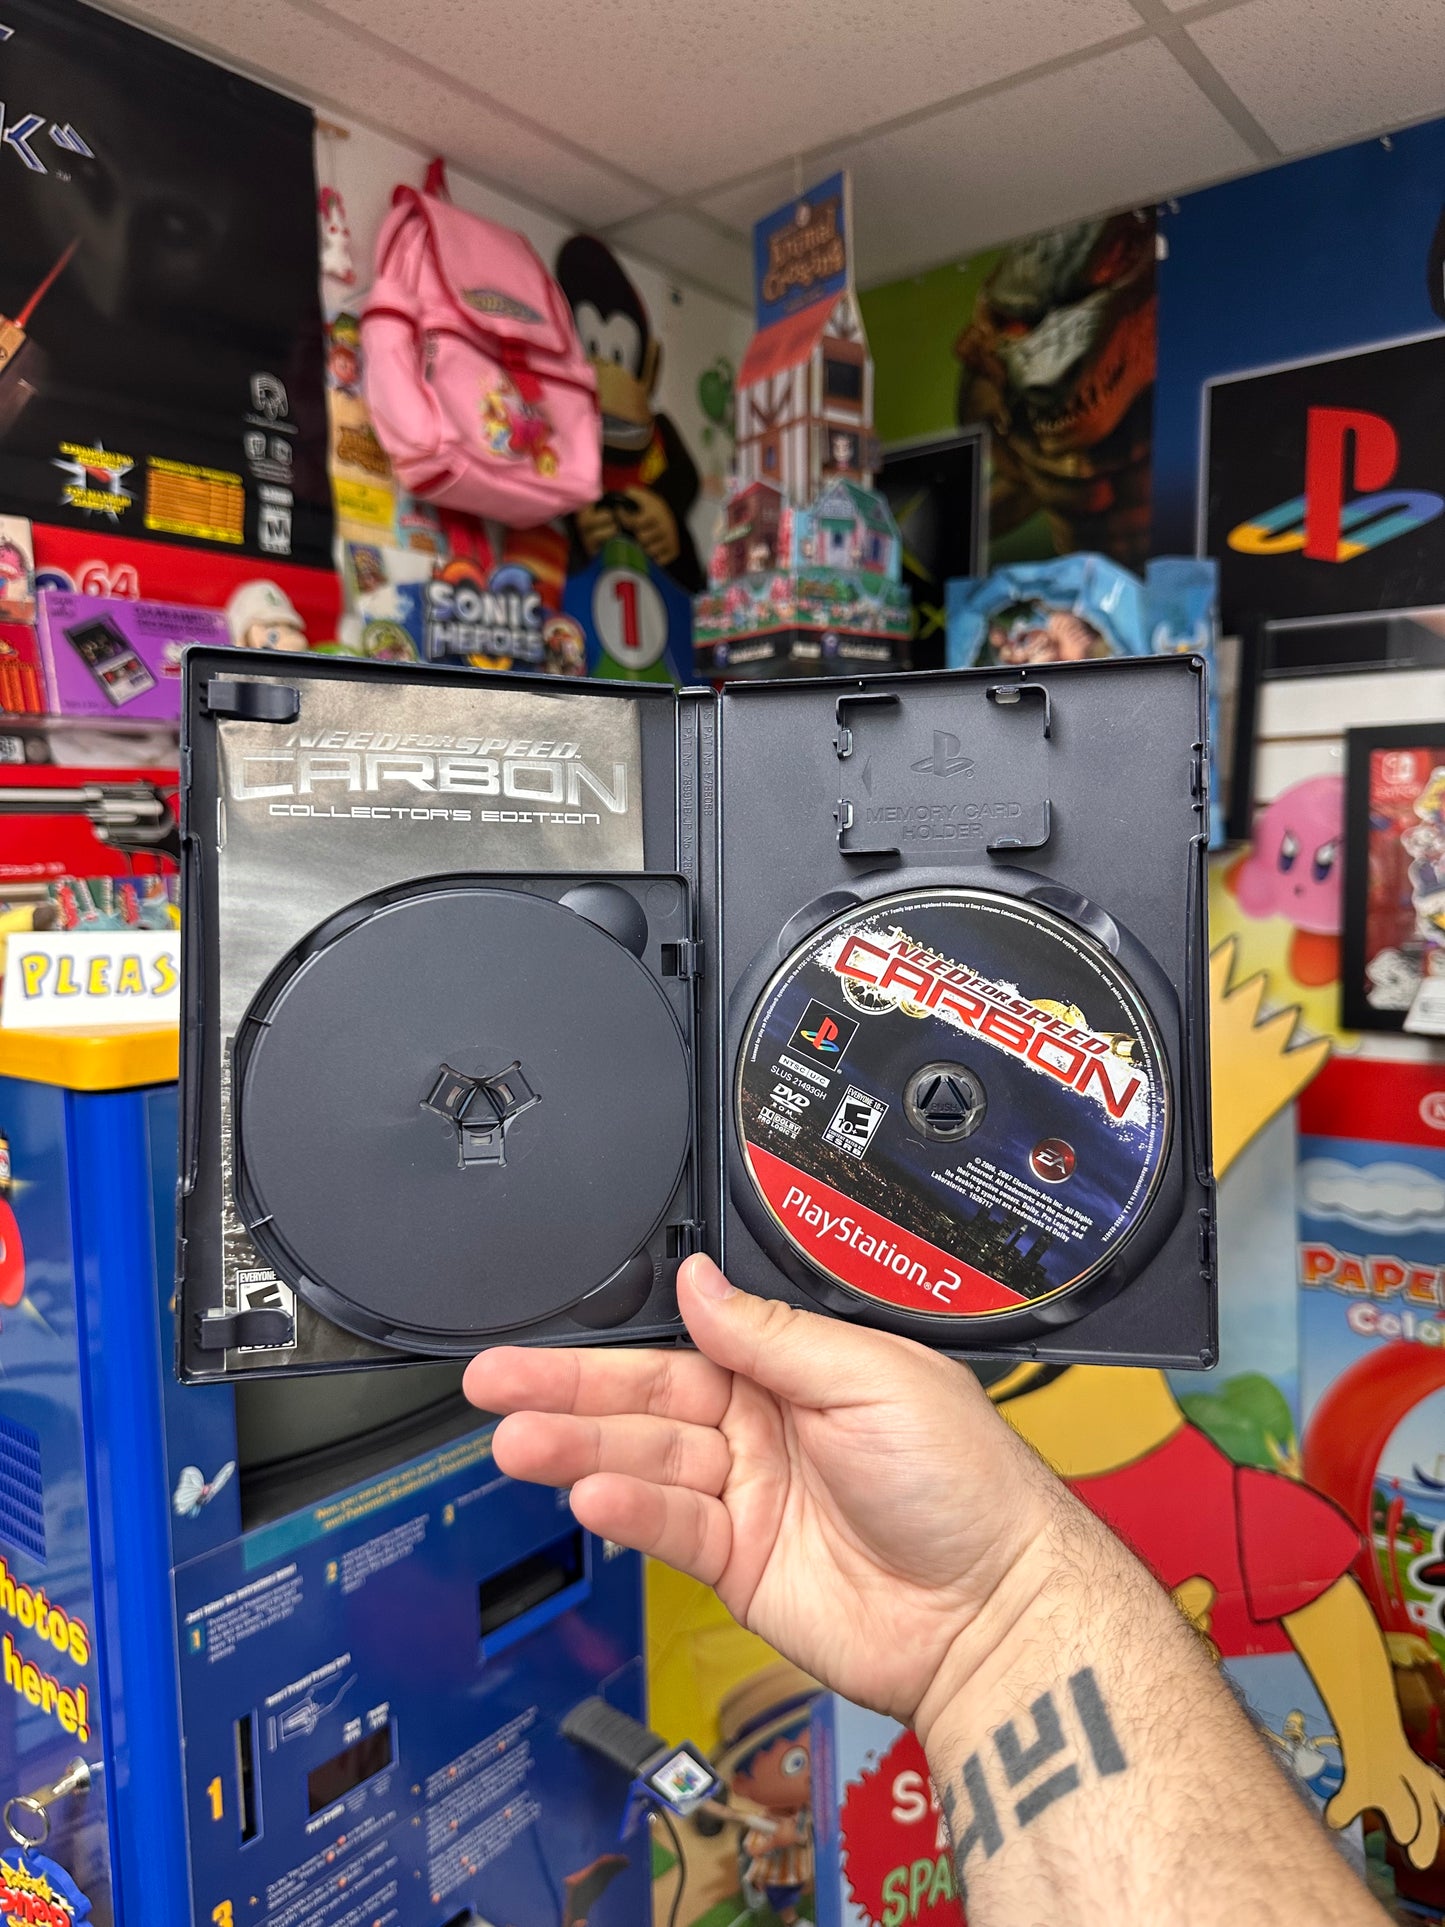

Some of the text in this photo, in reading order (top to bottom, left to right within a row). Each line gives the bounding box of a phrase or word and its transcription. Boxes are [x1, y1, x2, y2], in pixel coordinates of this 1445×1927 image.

[81, 561, 140, 601] 64
[425, 581, 543, 627] SONIC
[615, 580, 640, 649] 1
[426, 620, 545, 661] HEROES
[286, 730, 580, 759] NEED FOR SPEED
[703, 727, 713, 747] PAT
[230, 750, 629, 814] CARBON
[268, 803, 600, 825] COLLECTOR'S EDITION
[866, 802, 1023, 824] MEMORY CARD
[903, 823, 984, 841] HOLDER
[20, 952, 179, 999] PLEAS
[756, 1027, 765, 1038] play
[920, 901, 941, 909] registered
[980, 904, 1000, 915] Computer
[1034, 922, 1064, 942] Unauthorized
[1110, 984, 1124, 1000] public
[1119, 997, 1138, 1026] performance
[888, 940, 1110, 1055] NEED FOR SPEED
[835, 935, 1142, 1119] CARBON
[769, 1063, 828, 1100] SLUS 21493GH
[781, 1056, 826, 1085] NTSC U/C
[771, 1080, 812, 1111] DVD
[846, 1086, 875, 1106] EVERYONE
[931, 1102, 957, 1111] PUSH
[756, 1113, 771, 1125] PRO
[769, 1120, 791, 1136] LOGIC
[773, 1114, 800, 1133] DOLBY
[824, 1132, 862, 1156] ESRB
[929, 1170, 969, 1196] Laboratories.
[1036, 1148, 1067, 1175] EA
[943, 1168, 1071, 1242] the double-D symbol are trademarks of Dolby
[955, 1165, 1084, 1240] their respective owners. Dolby, Pro Logic, and
[965, 1161, 1088, 1232] Reserved. All trademarks are the property of
[980, 1159, 998, 1174] 2006,
[996, 1168, 1013, 1182] 2007
[1011, 1176, 1041, 1197] Electronic
[1039, 1192, 1054, 1204] Arts
[1051, 1198, 1065, 1210] Inc.
[1063, 1205, 1075, 1215] All
[1072, 1210, 1095, 1226] Rights
[1299, 1242, 1445, 1308] PAPE
[1346, 1301, 1445, 1346] Colo
[0, 1555, 90, 1667] hotos
[2, 1631, 91, 1744] here!
[207, 1776, 224, 1821] 1
[882, 1854, 955, 1927] SPA
